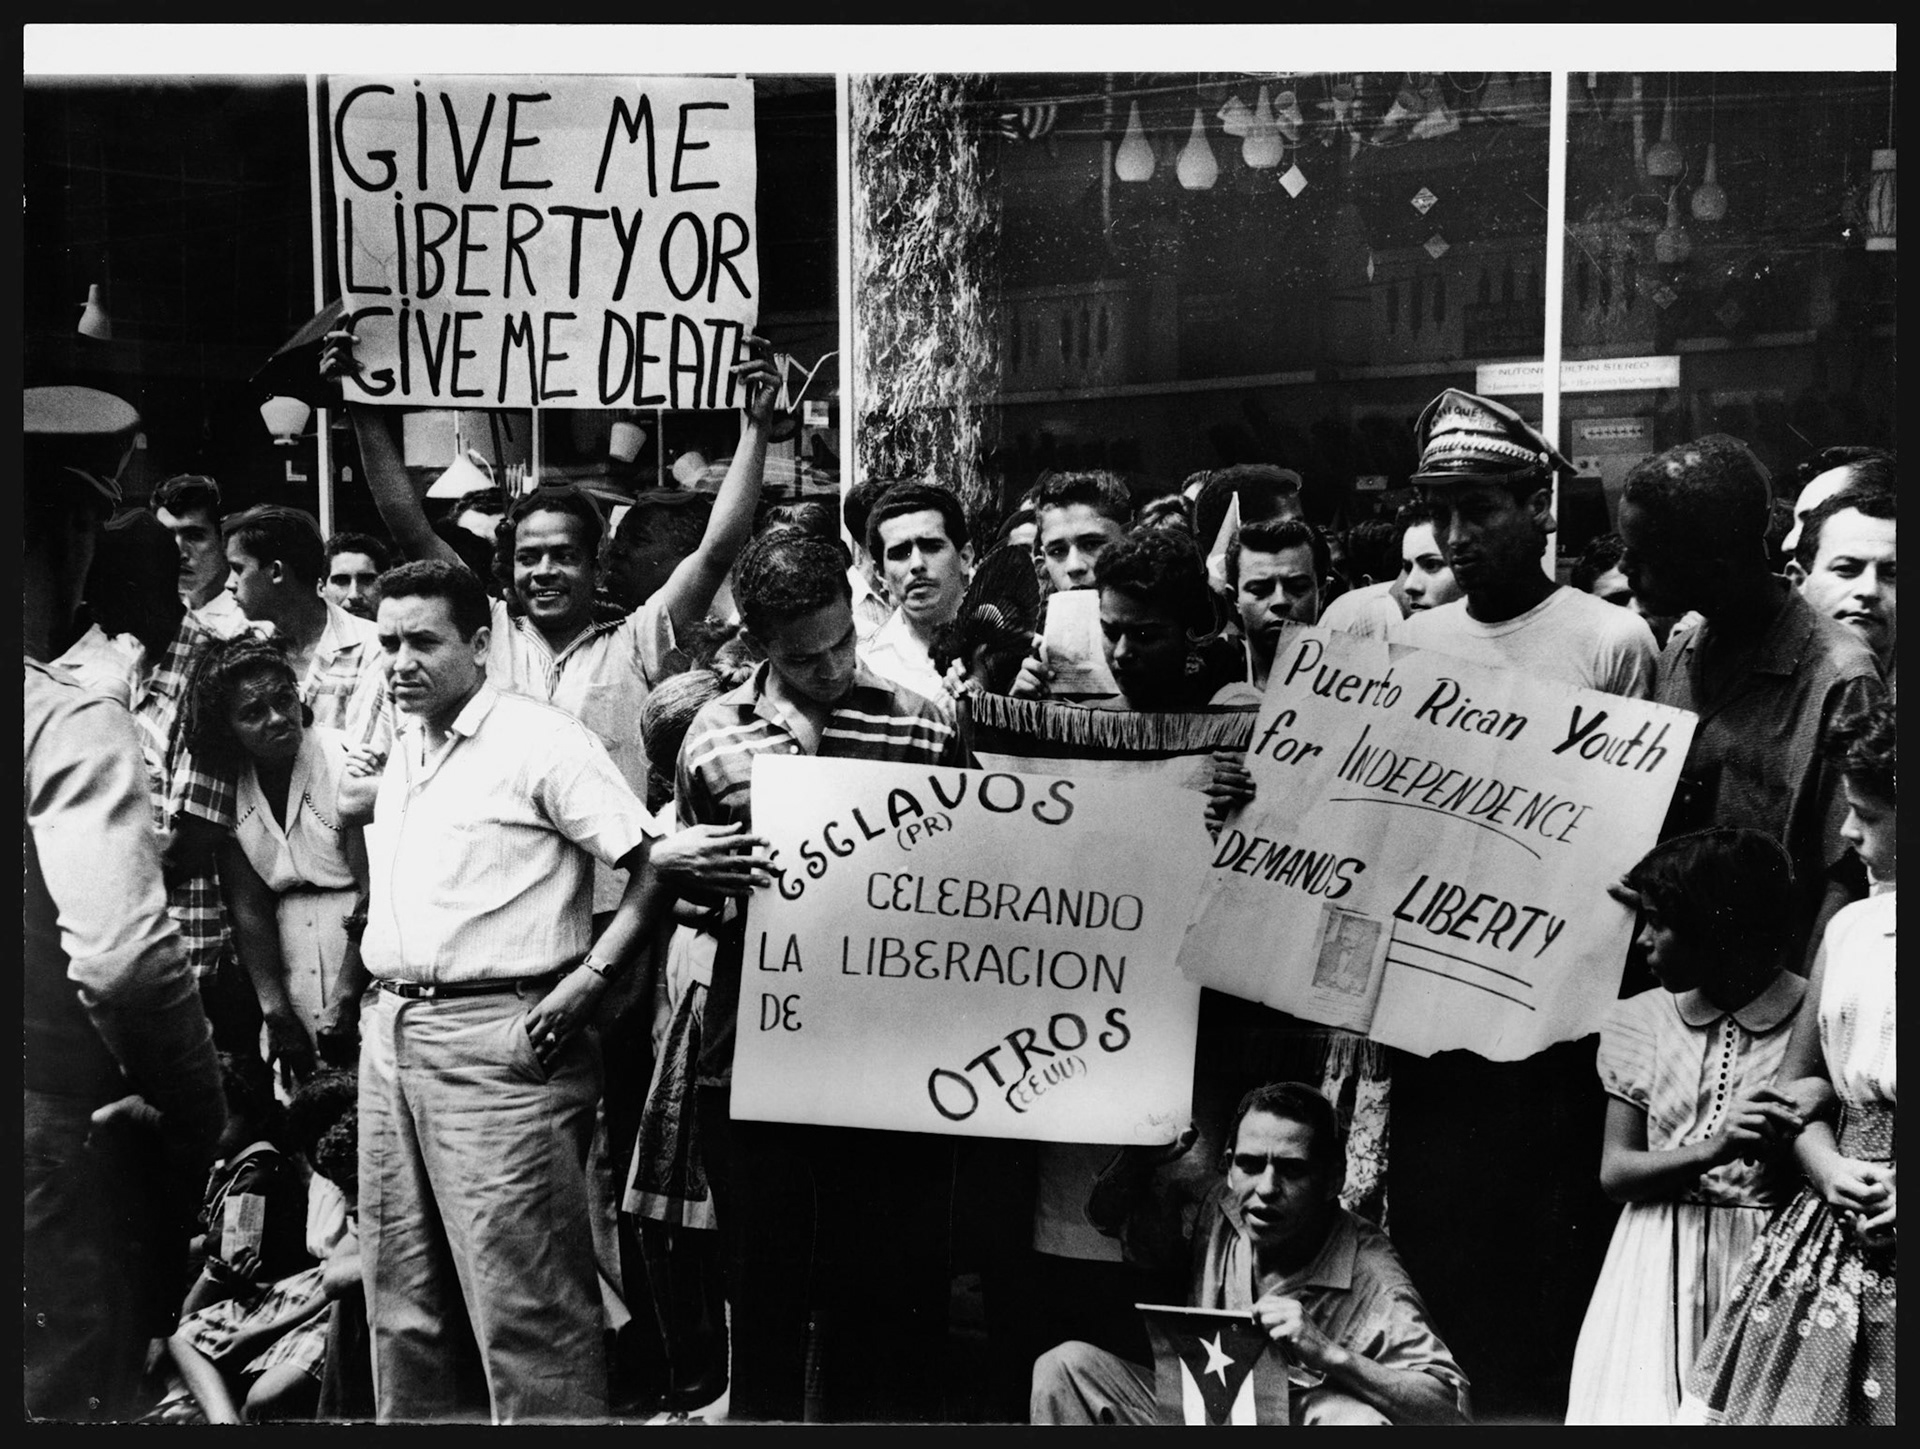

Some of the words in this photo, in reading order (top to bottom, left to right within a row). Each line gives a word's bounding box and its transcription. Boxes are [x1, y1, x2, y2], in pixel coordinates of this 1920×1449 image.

[594, 93, 729, 197] ME
[660, 211, 751, 302] OR
[498, 311, 577, 405] ME
[1284, 638, 1402, 709] Puerto
[1414, 677, 1528, 741] Rican
[1552, 705, 1671, 773] Youth
[1254, 710, 1323, 765] for
[1337, 724, 1593, 845] INDEPENDENCE
[866, 872, 1144, 931] CELEBRANDO
[1211, 829, 1367, 899] DEMANDS
[1392, 875, 1566, 958] LIBERTY
[758, 931, 803, 973] LA
[841, 936, 1127, 994] LIBERACION
[760, 993, 803, 1032] DE
[927, 1007, 1131, 1121] OTROS
